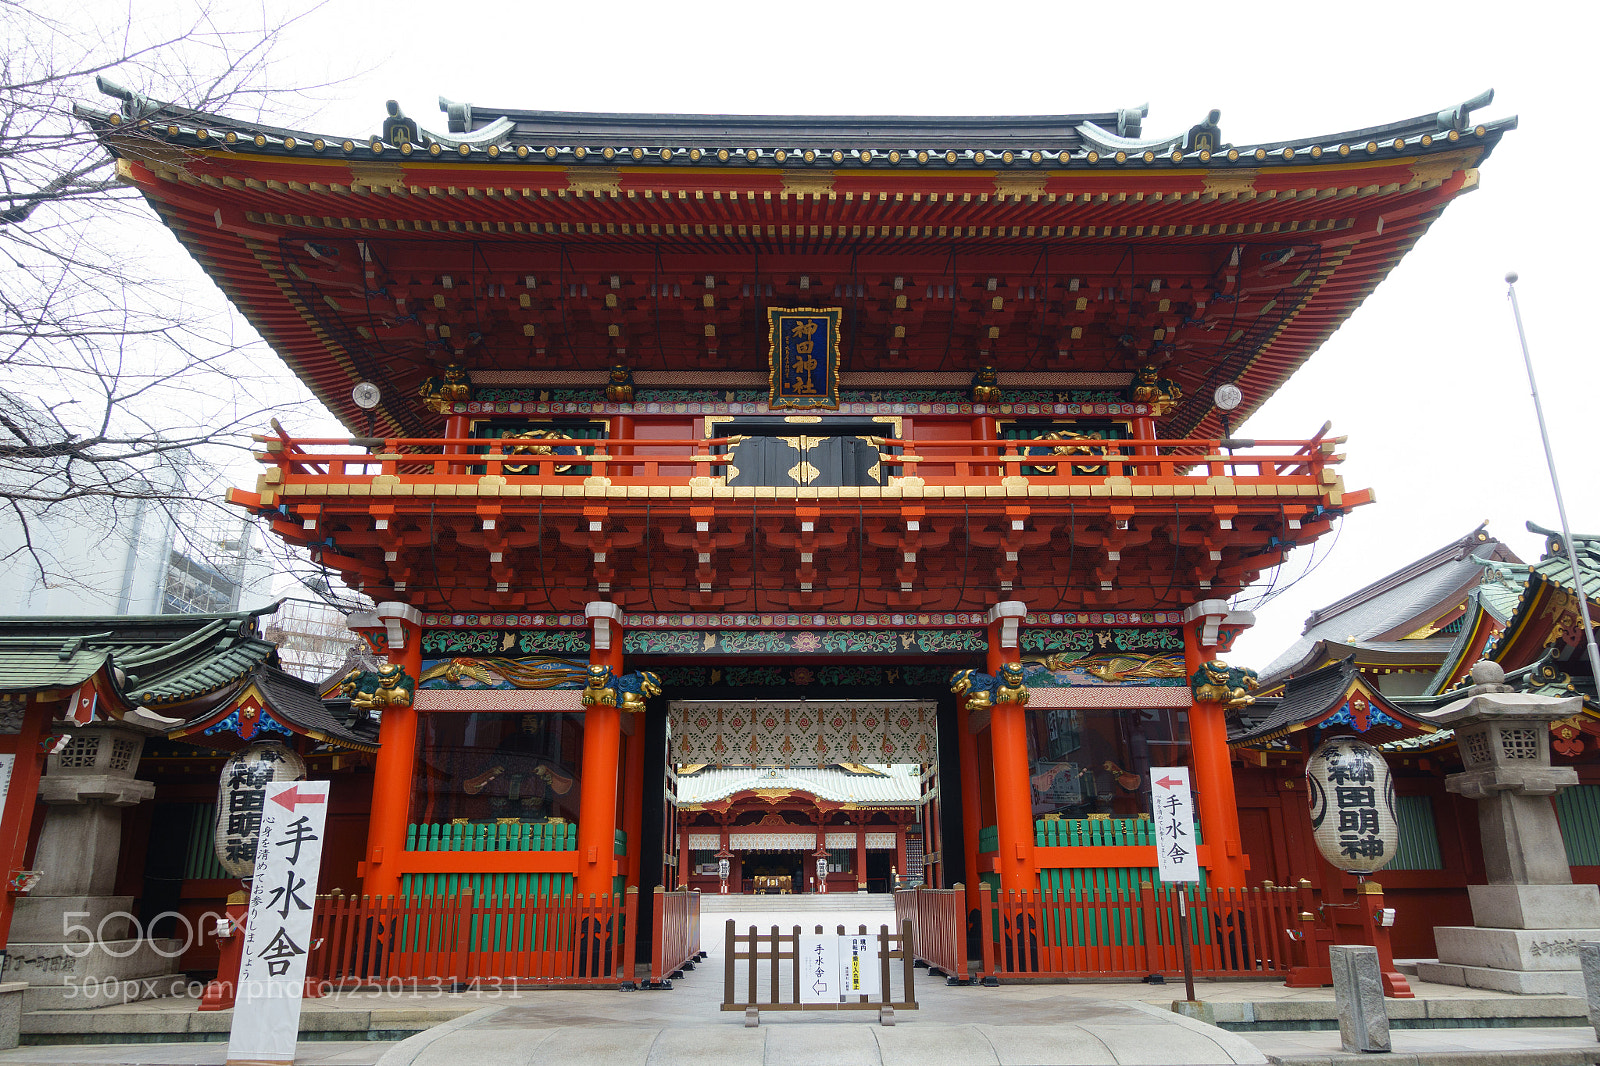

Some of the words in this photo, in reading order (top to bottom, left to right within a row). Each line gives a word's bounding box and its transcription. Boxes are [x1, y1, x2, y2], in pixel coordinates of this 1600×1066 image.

[792, 319, 818, 394] 神田神社
[1163, 794, 1190, 865] 手水舎
[1327, 758, 1384, 860] 神田明神
[242, 816, 276, 982] 心身を清めてお参りしましょう
[257, 815, 319, 978] 手水舎
[814, 944, 825, 978] 手水舎
